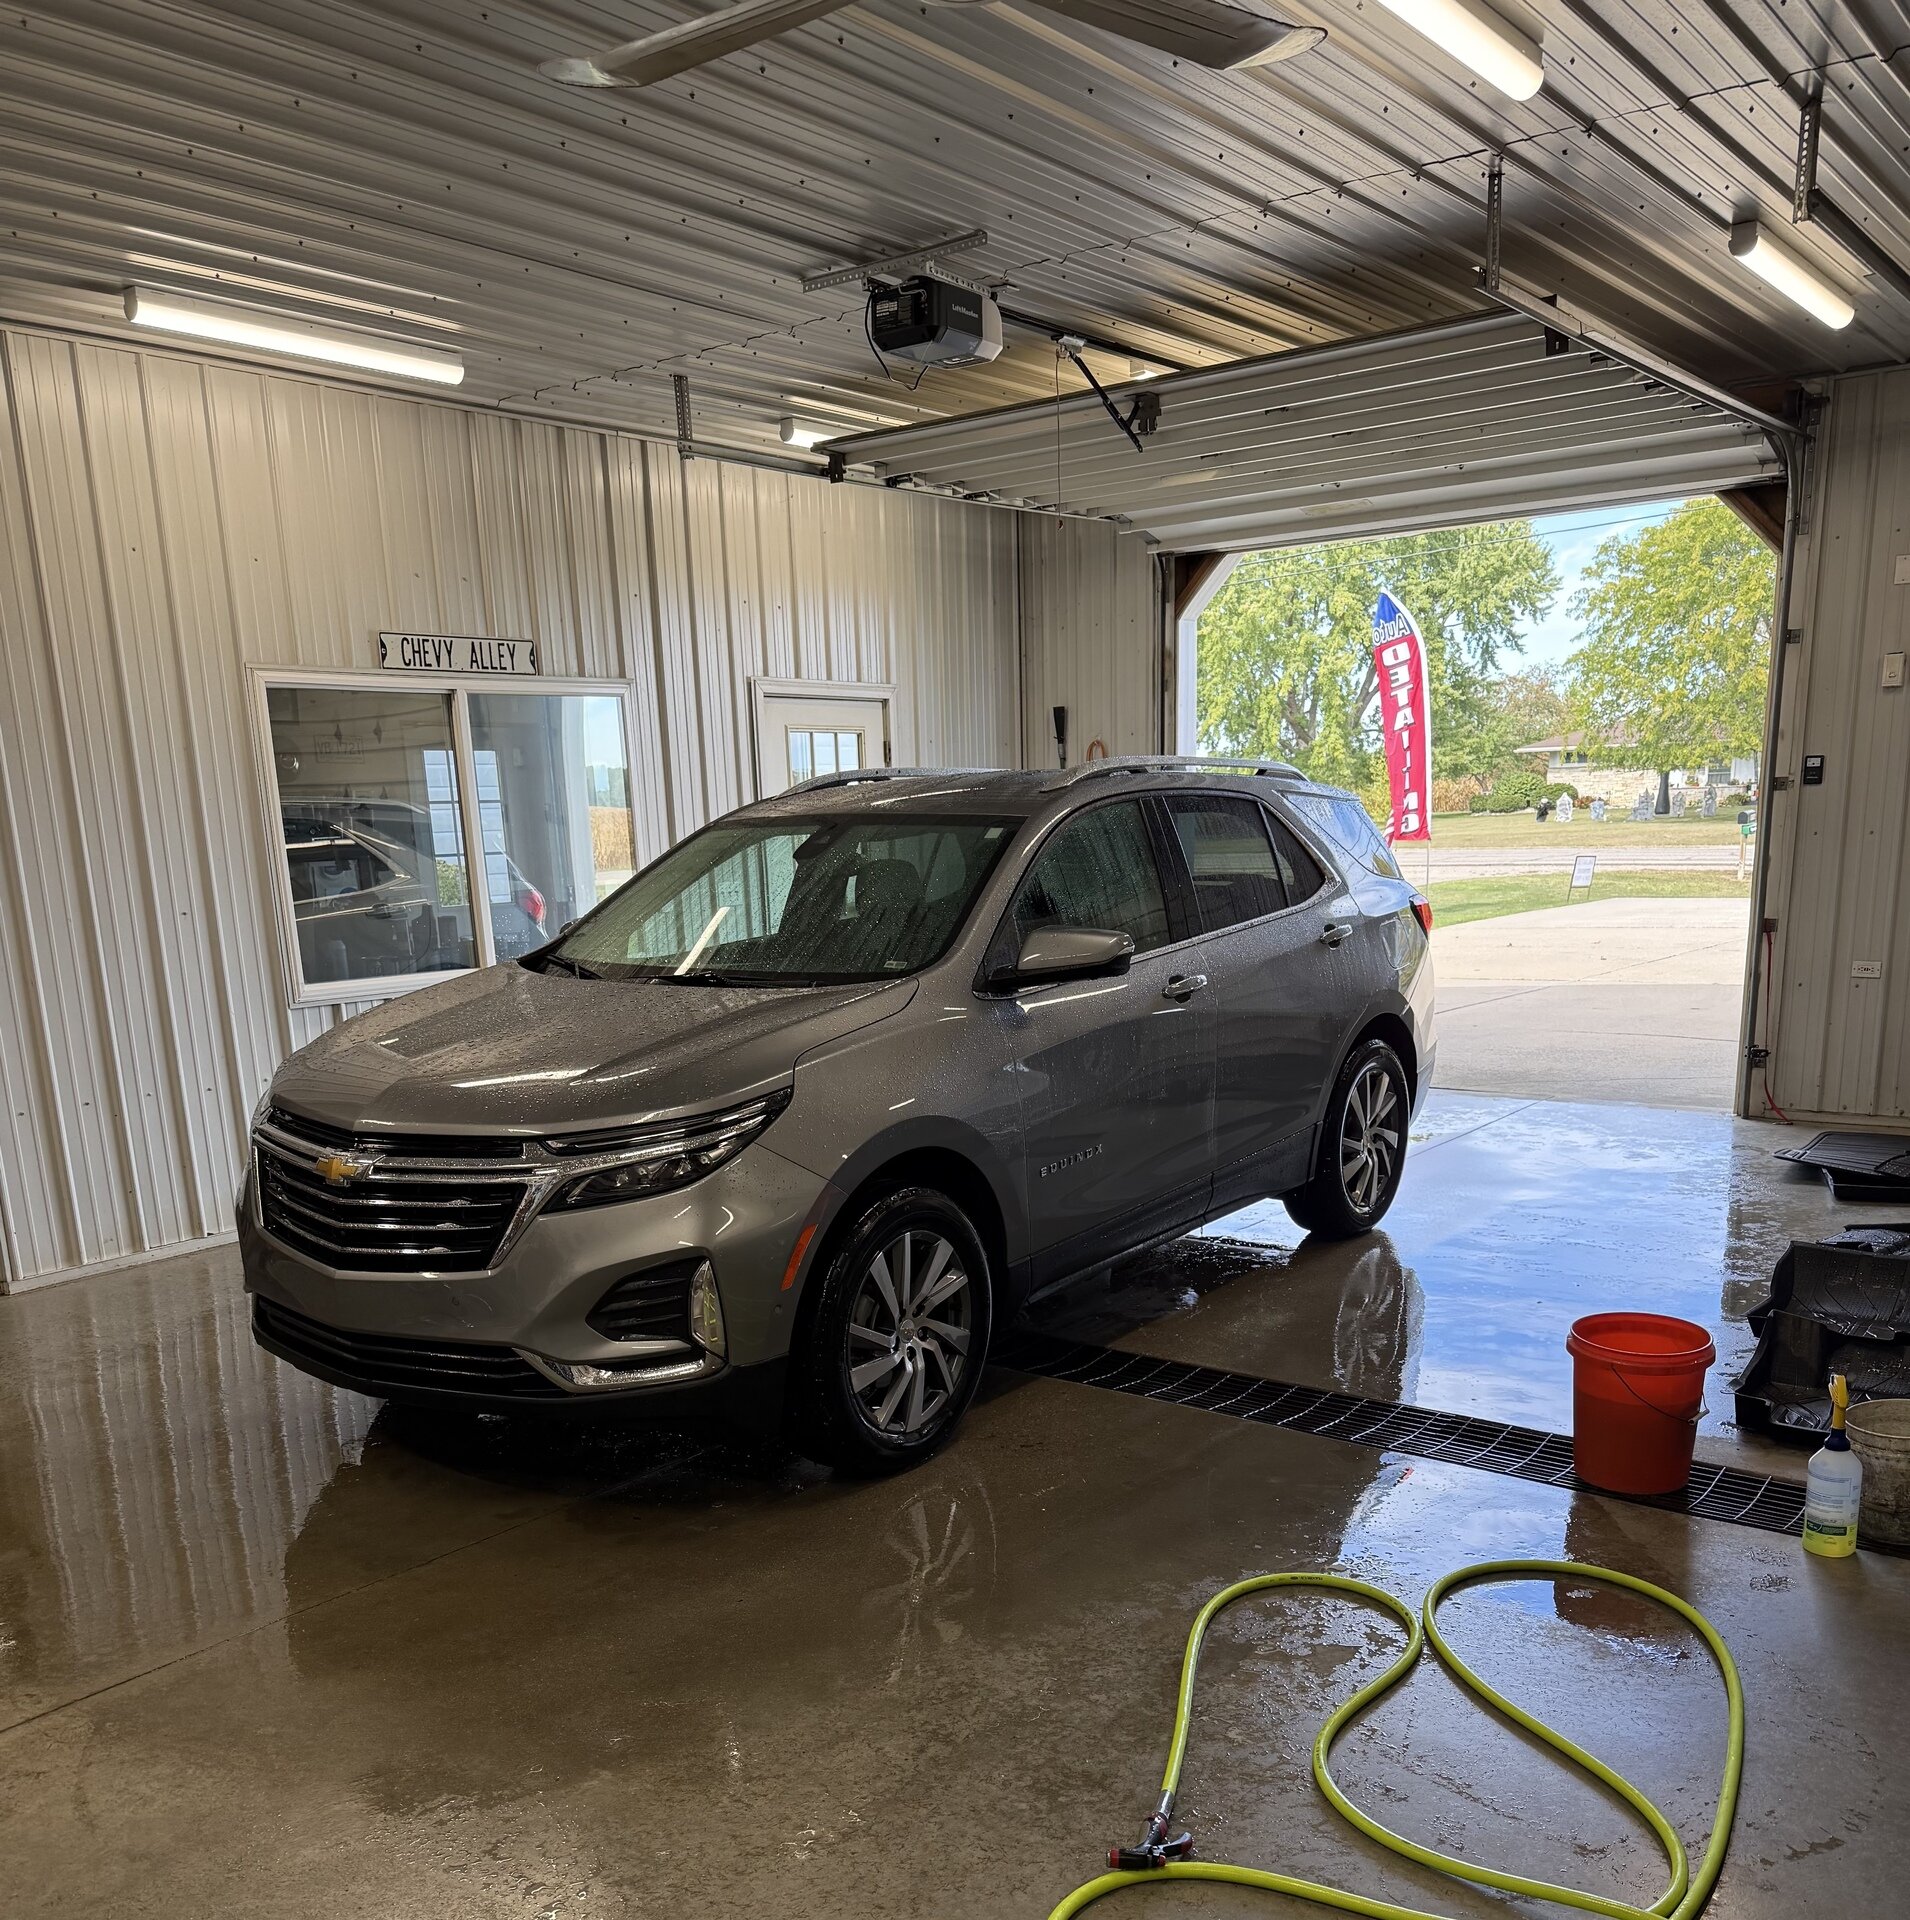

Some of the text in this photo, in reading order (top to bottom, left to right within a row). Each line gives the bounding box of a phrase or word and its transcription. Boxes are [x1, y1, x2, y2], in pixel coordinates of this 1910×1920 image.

[400, 637, 516, 671] CHEVY ALLEY
[1040, 1143, 1103, 1178] EQUINOX
